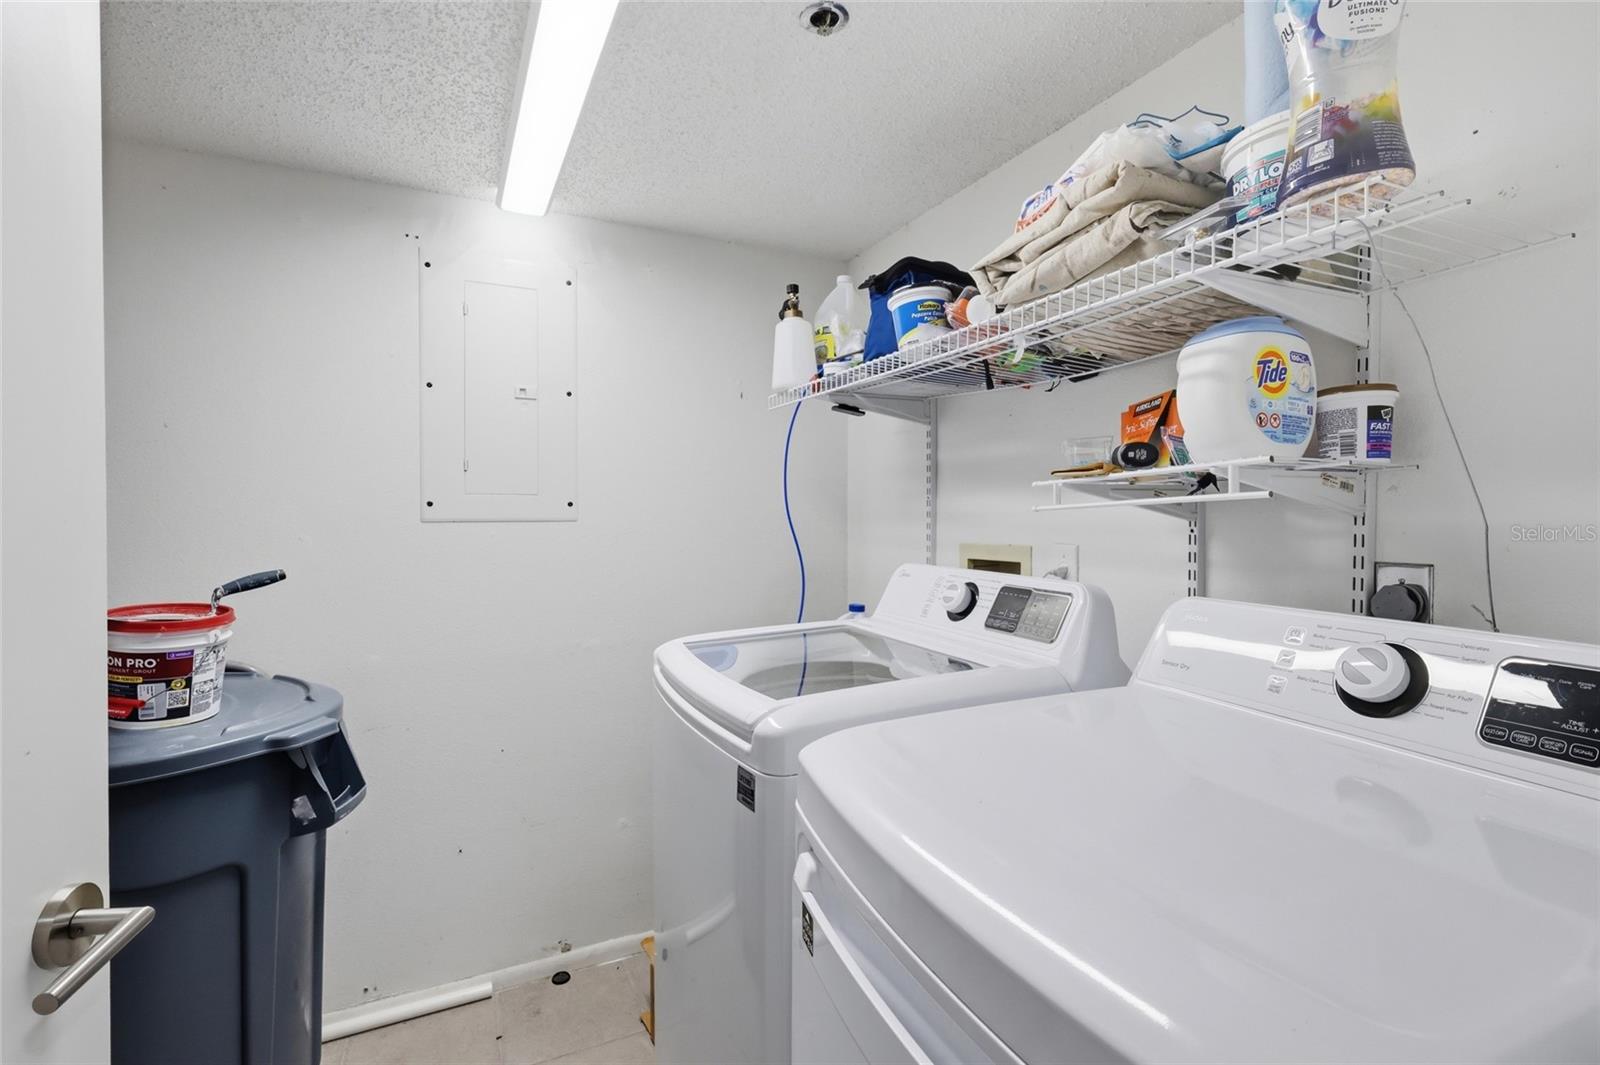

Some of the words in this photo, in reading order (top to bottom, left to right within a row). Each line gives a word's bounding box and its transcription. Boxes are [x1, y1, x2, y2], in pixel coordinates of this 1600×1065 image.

[1347, 0, 1387, 11] ULTIMATE
[1348, 7, 1386, 17] FUSIONS
[1233, 162, 1284, 197] DRYLO
[1257, 359, 1288, 389] Tide
[1370, 422, 1391, 430] FAST
[127, 658, 157, 669] PRO
[1180, 662, 1190, 671] Dry
[1561, 723, 1590, 734] ADJUST
[1568, 719, 1586, 728] TIME
